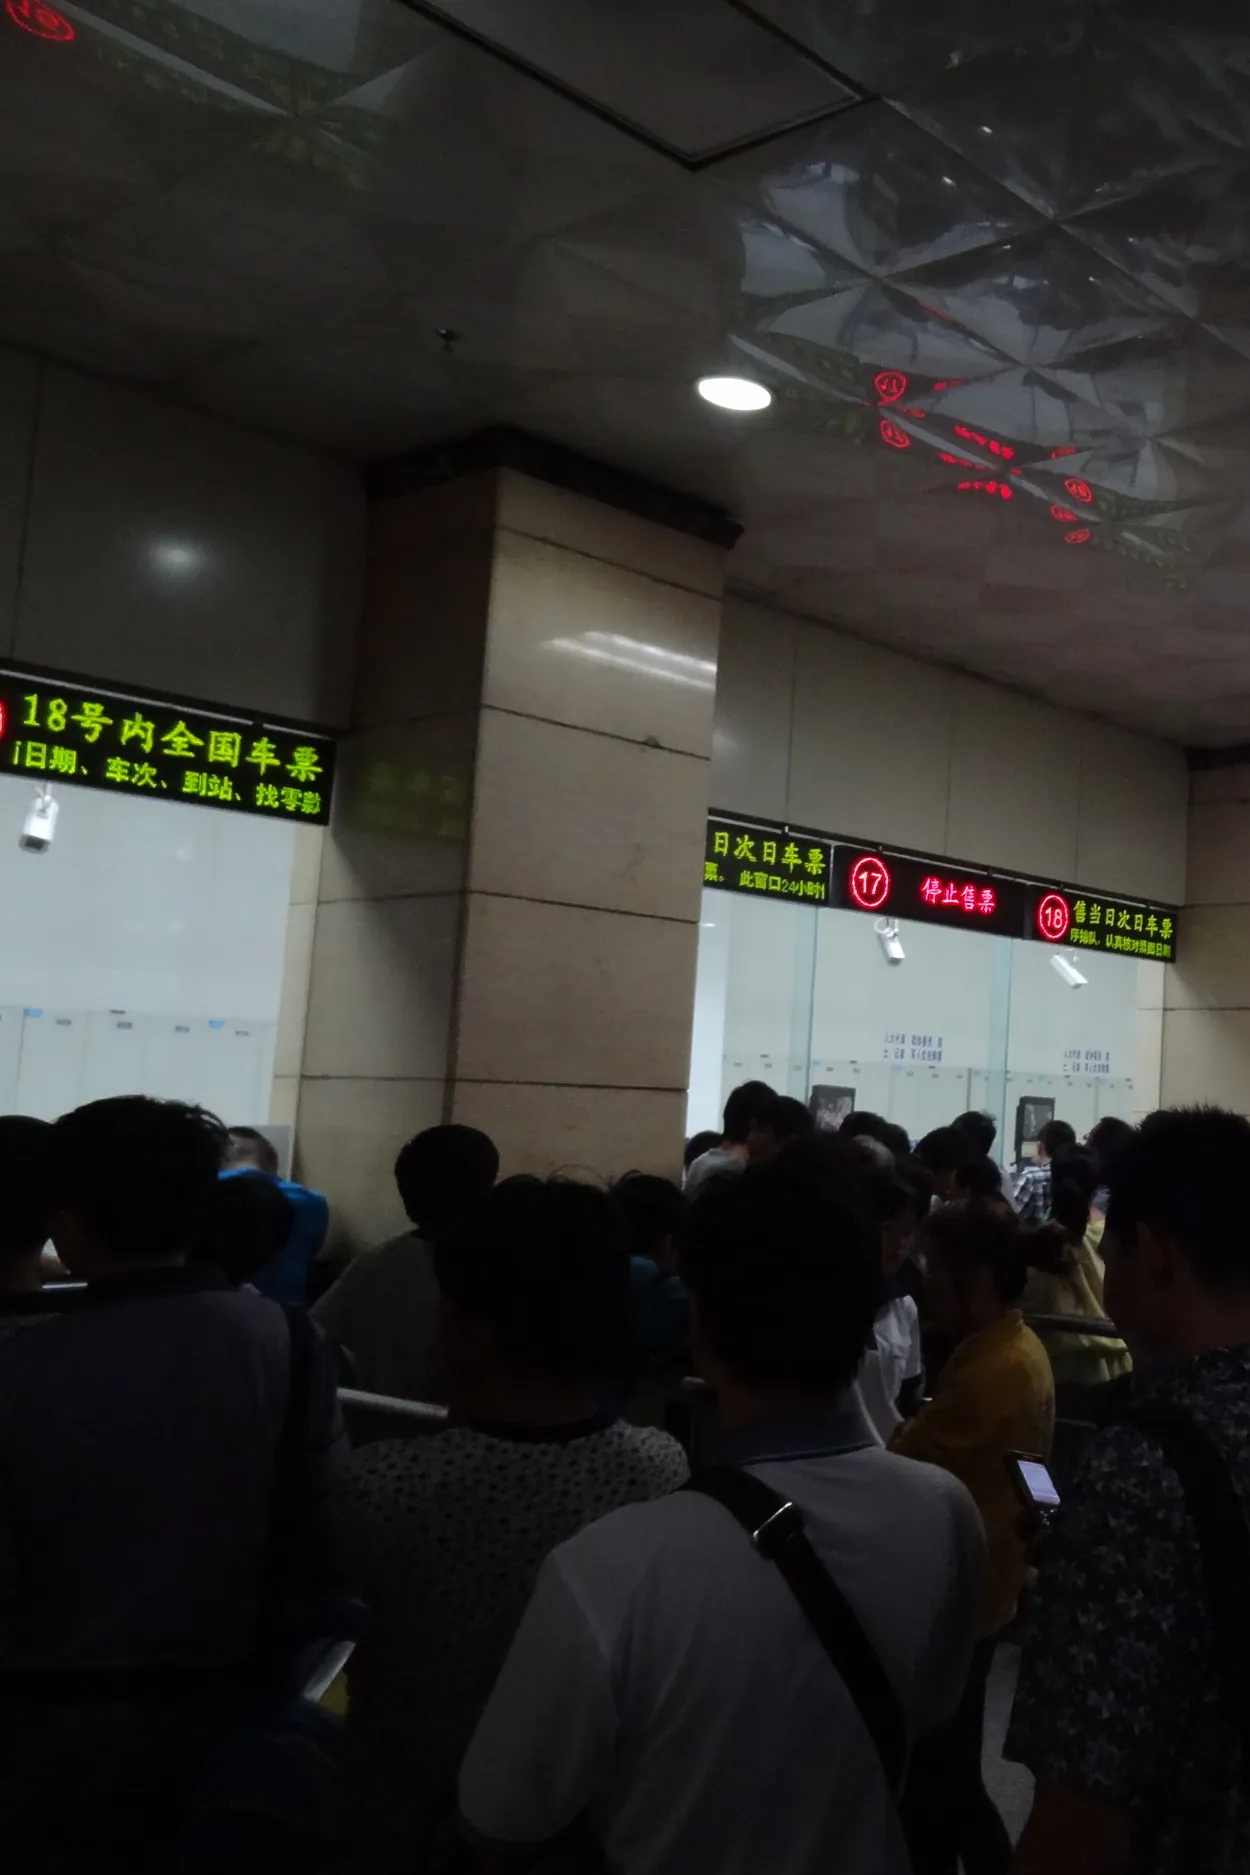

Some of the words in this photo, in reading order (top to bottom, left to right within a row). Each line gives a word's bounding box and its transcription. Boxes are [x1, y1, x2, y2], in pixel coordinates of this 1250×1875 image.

[23, 692, 324, 783] 18号内全国车票
[713, 831, 826, 876] 日次日车票
[921, 878, 995, 913] 停止售票
[1073, 900, 1173, 939] 售当日次日车票
